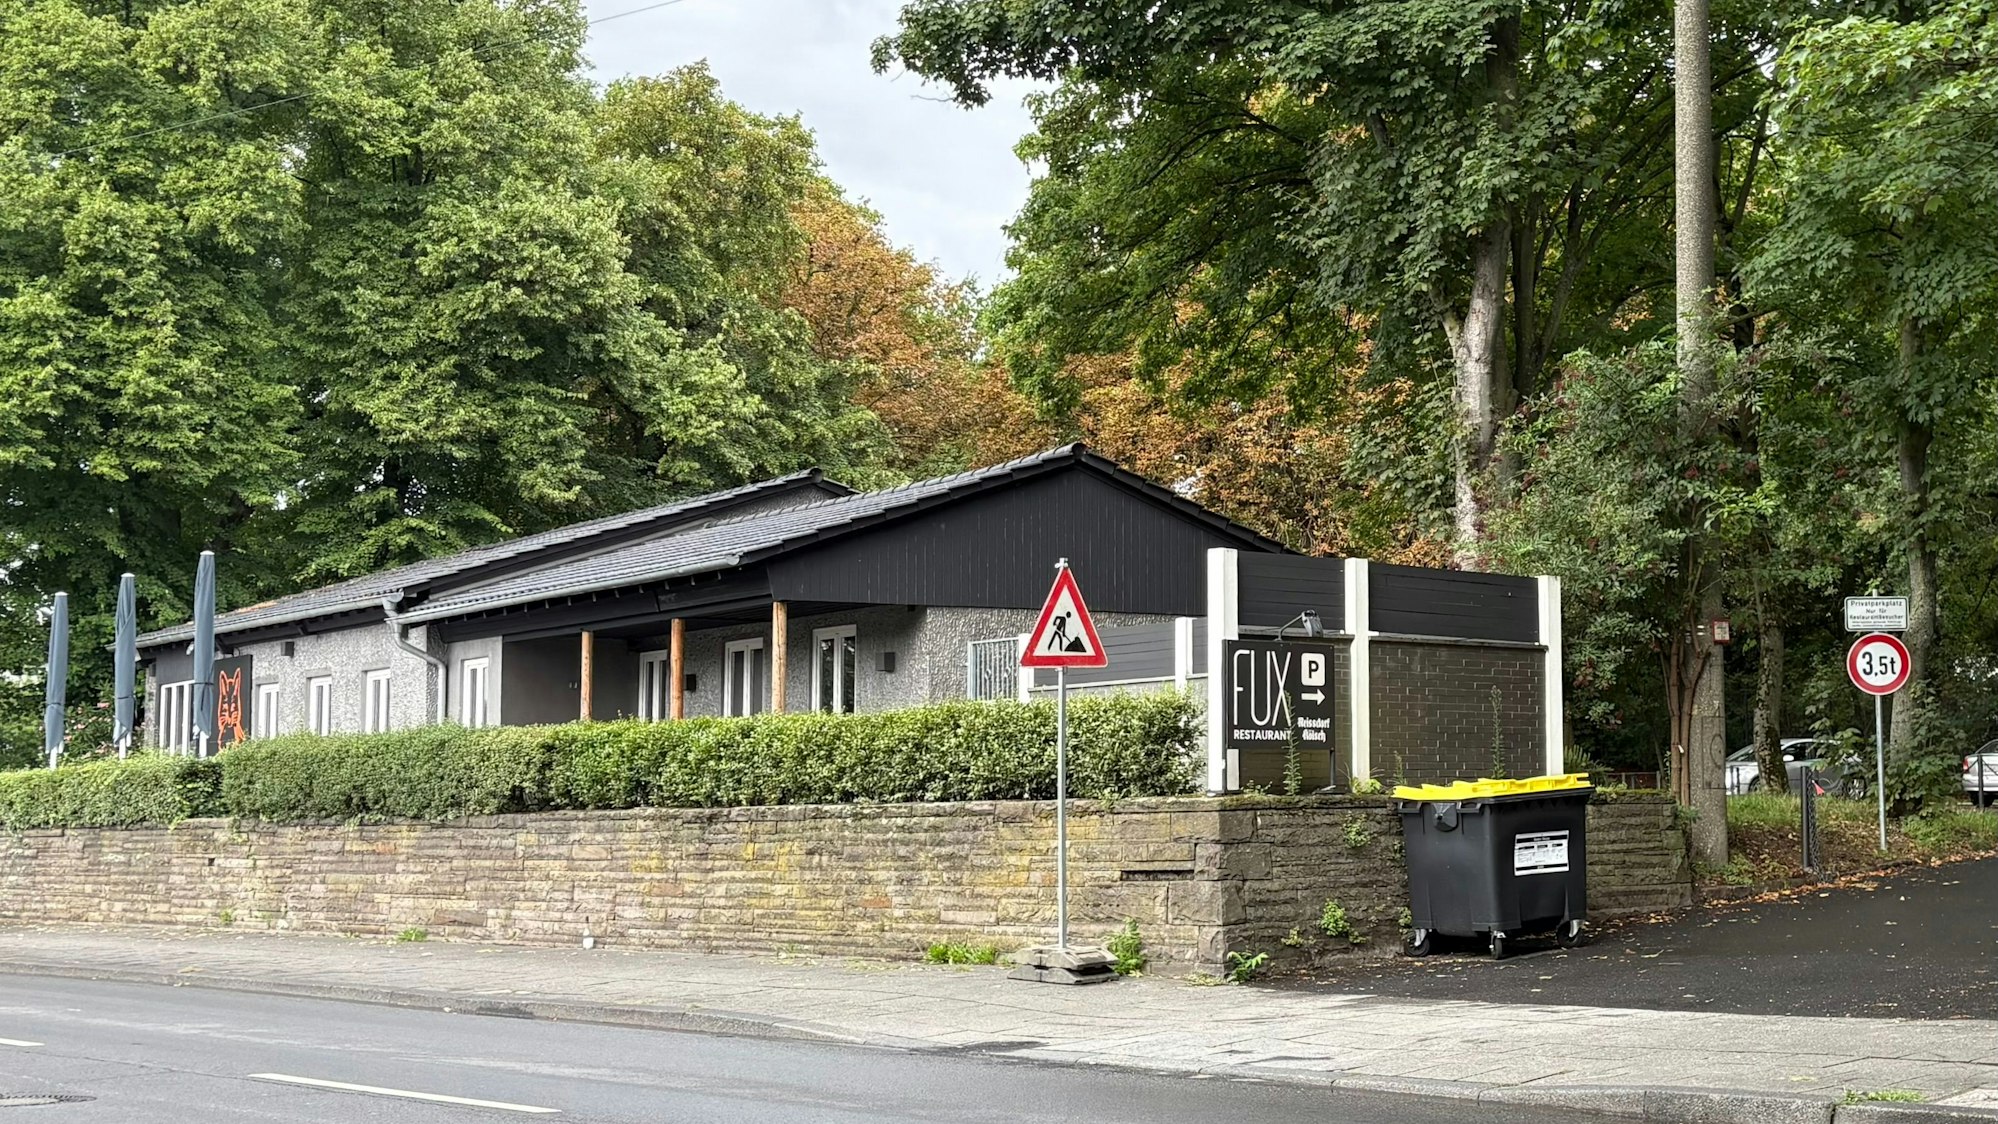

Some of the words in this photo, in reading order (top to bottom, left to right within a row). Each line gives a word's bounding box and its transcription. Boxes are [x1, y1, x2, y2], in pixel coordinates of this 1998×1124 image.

[1308, 660, 1319, 679] P
[1234, 649, 1292, 726] FUX
[1234, 729, 1292, 740] RESTAURANT
